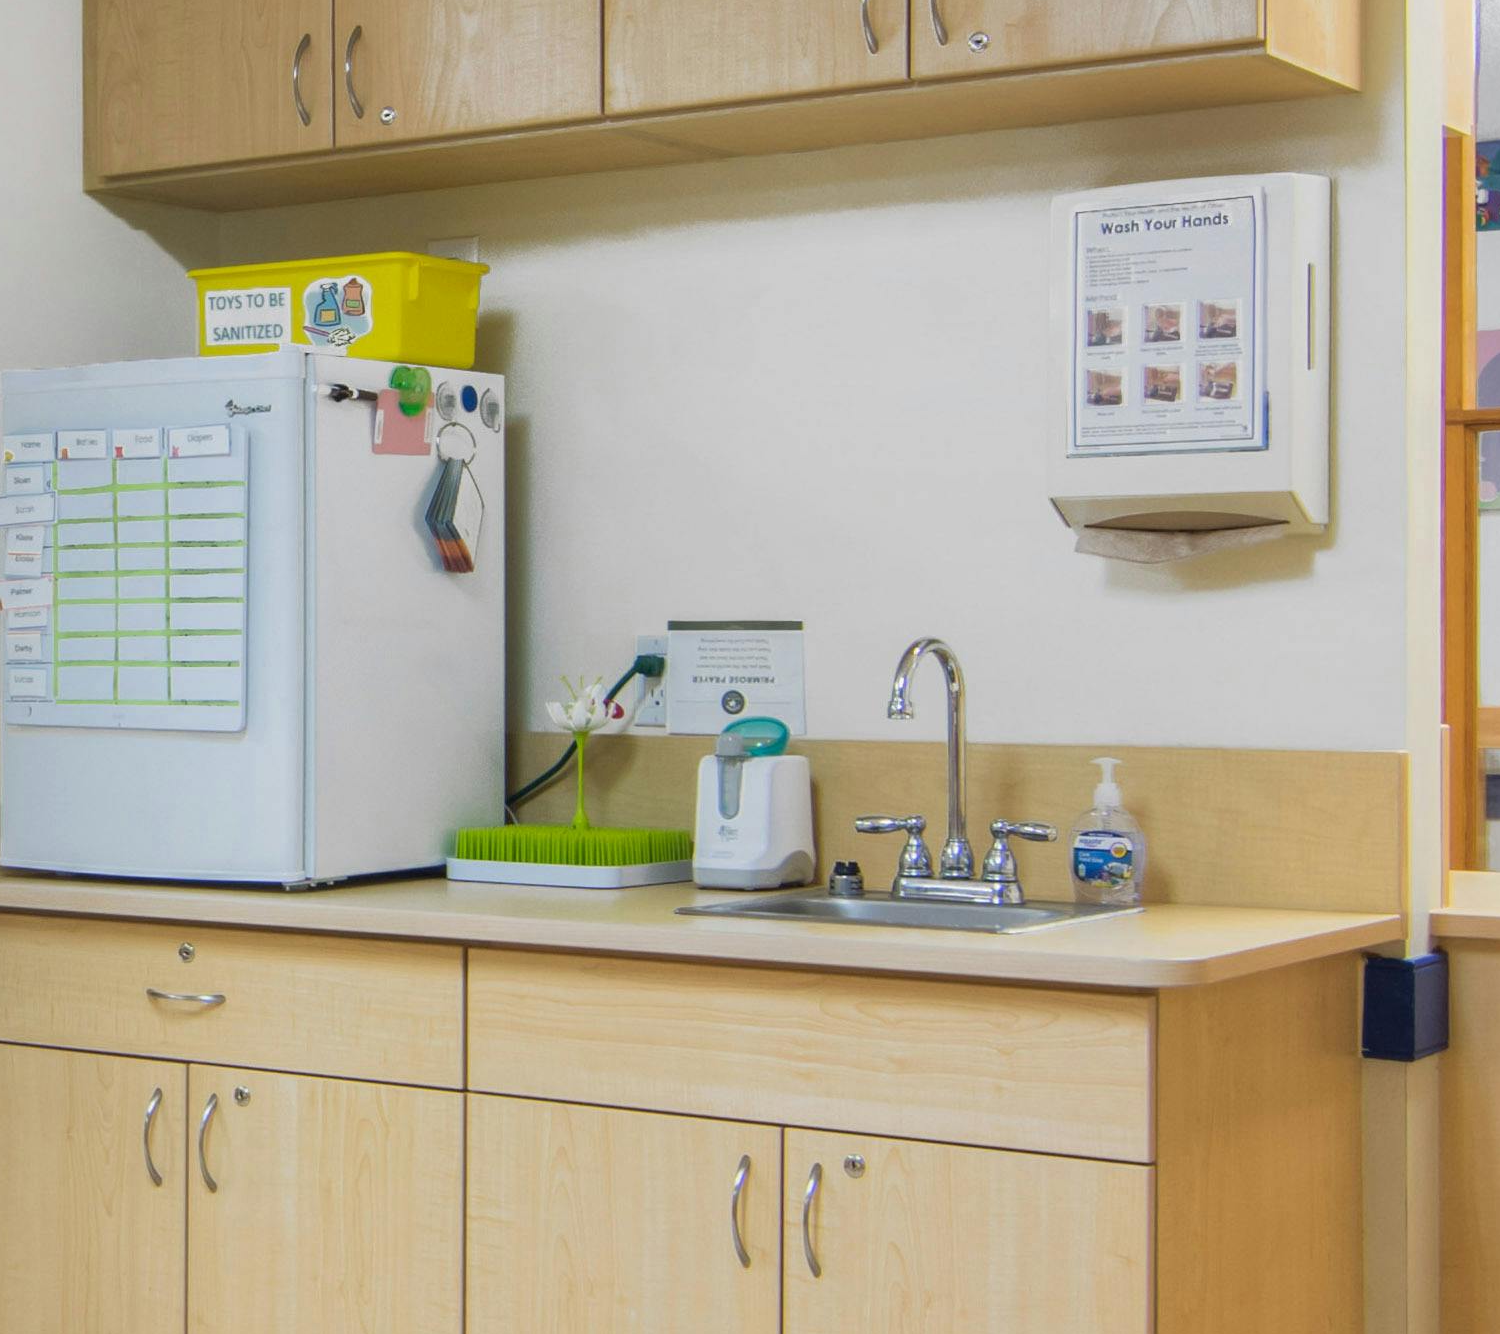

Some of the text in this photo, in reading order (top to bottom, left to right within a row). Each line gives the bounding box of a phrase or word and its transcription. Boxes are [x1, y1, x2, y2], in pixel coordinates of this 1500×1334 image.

[1101, 212, 1229, 235] Wash Your Hands
[208, 292, 285, 310] TOYS TO BE
[213, 324, 284, 342] SANITIZED
[692, 675, 775, 685] PRIMROSE PRAYER
